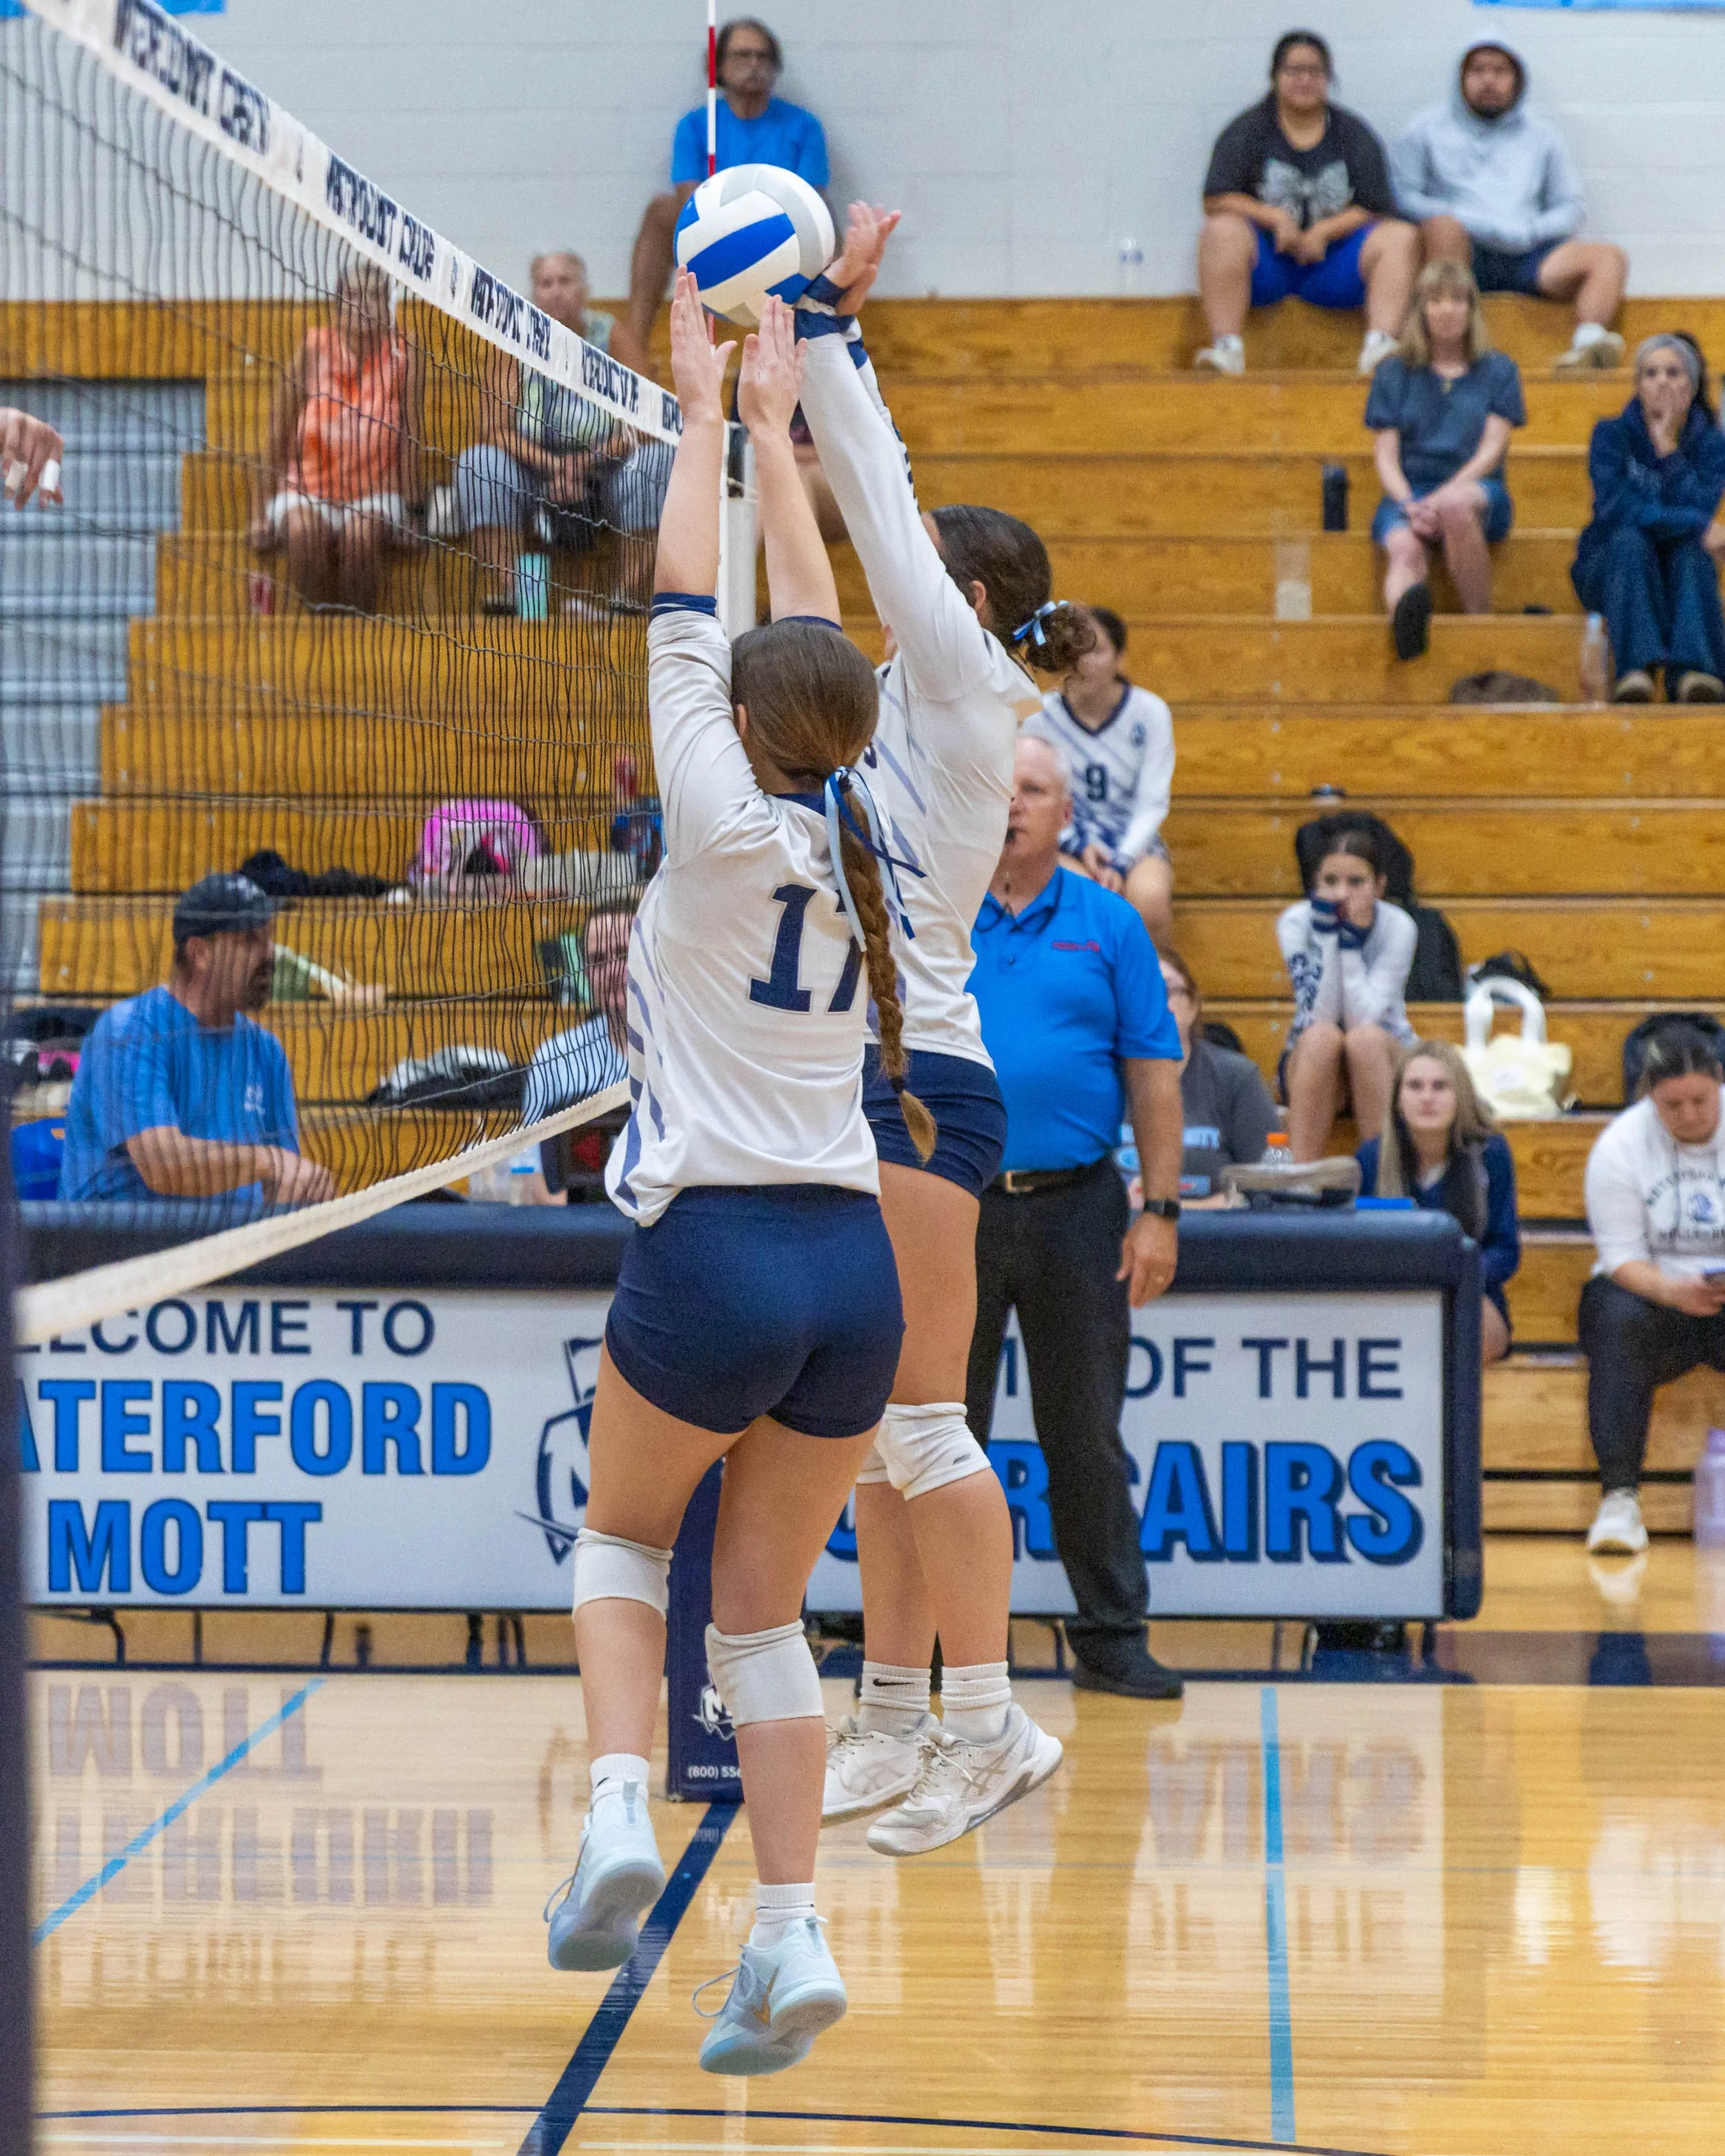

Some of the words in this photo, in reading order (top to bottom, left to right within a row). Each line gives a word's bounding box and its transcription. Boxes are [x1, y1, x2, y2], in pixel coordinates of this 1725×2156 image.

[1085, 763, 1108, 801] 9
[337, 1300, 435, 1356] TO
[1123, 1336, 1215, 1398] OF
[1241, 1337, 1404, 1400] THE
[19, 1379, 493, 1476] TERFORD
[48, 1499, 323, 1595] MOTT
[689, 1766, 719, 1779] (800)
